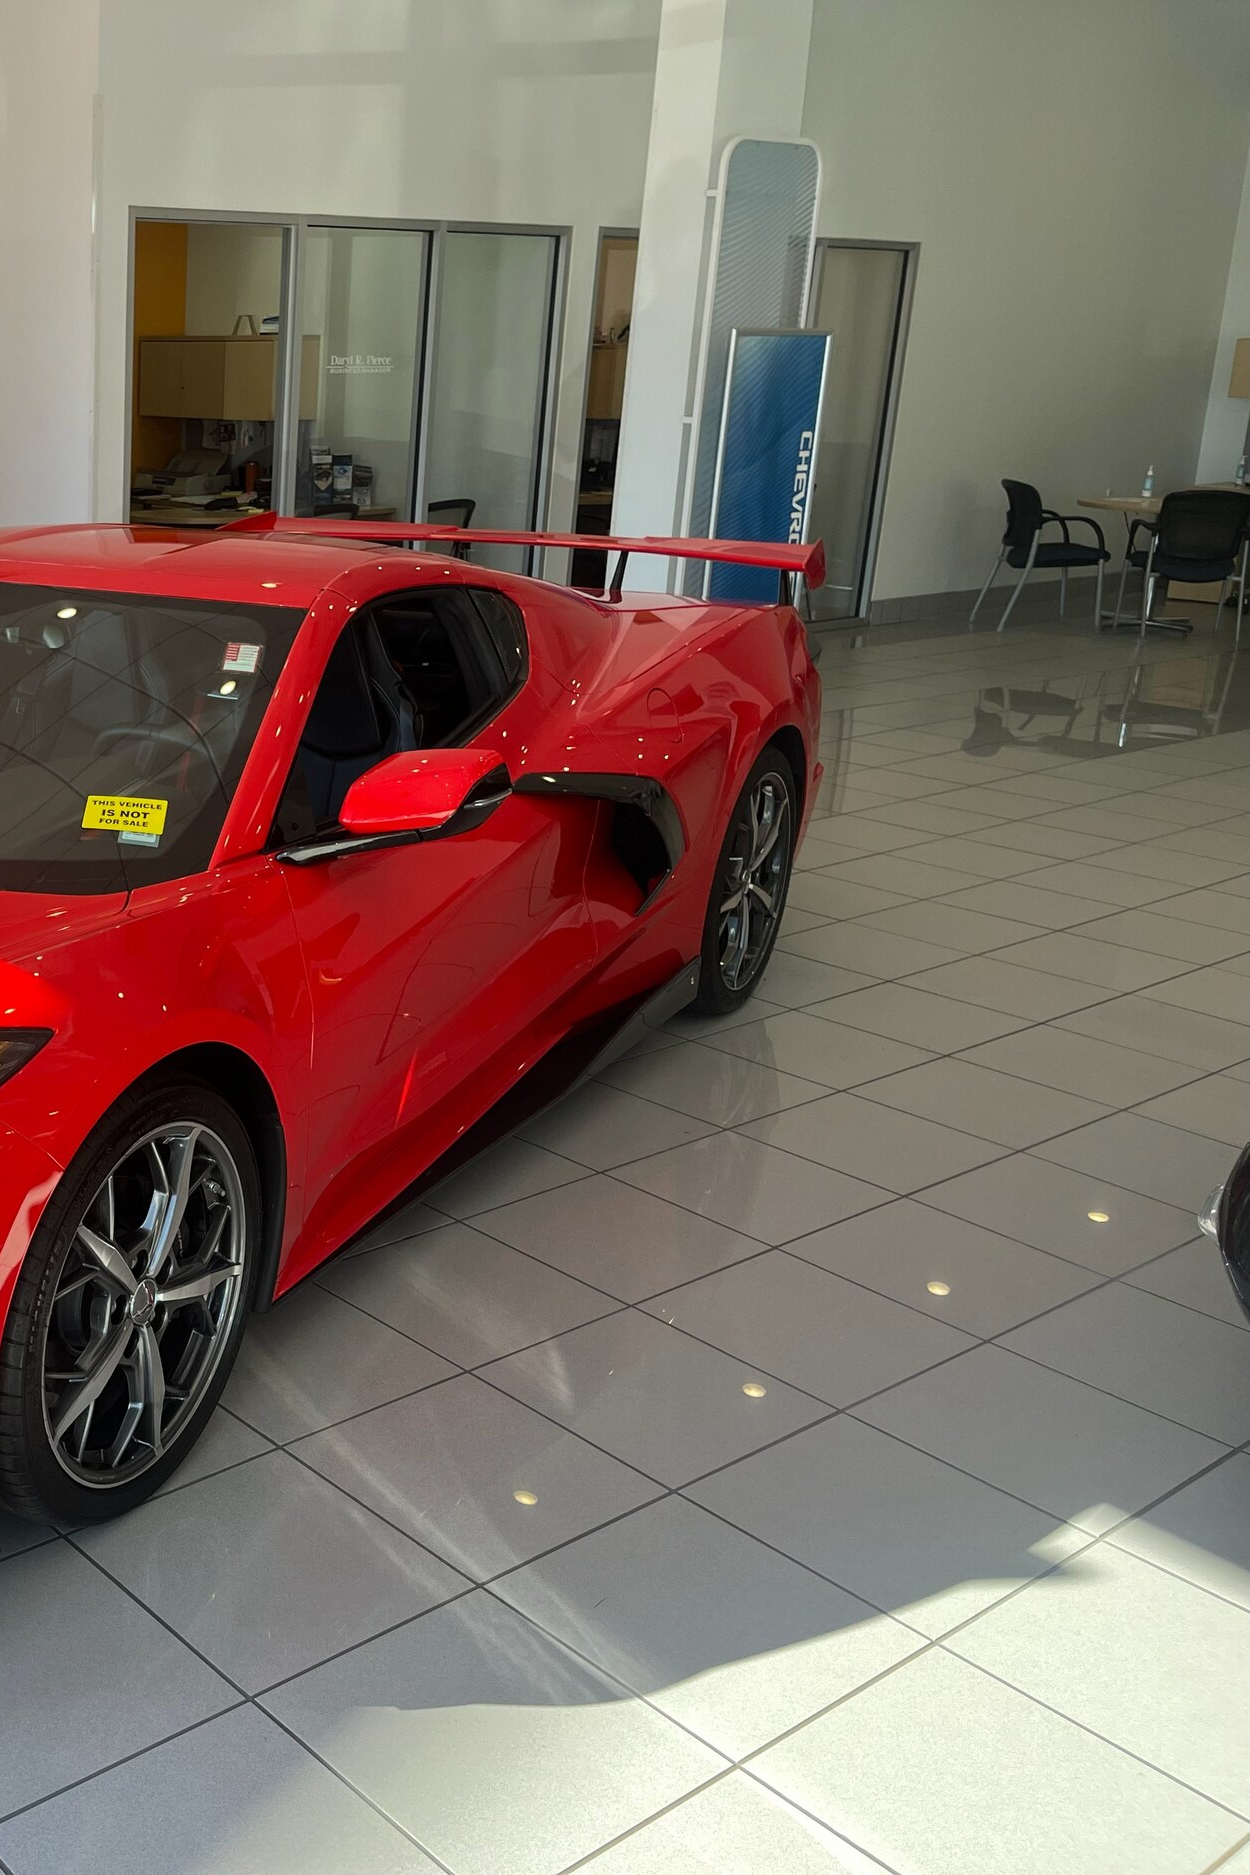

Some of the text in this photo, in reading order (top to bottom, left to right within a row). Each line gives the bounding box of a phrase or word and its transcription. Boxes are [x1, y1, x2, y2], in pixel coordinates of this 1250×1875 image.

[120, 801, 162, 810] VEHICLE
[101, 809, 150, 819] IS NOT
